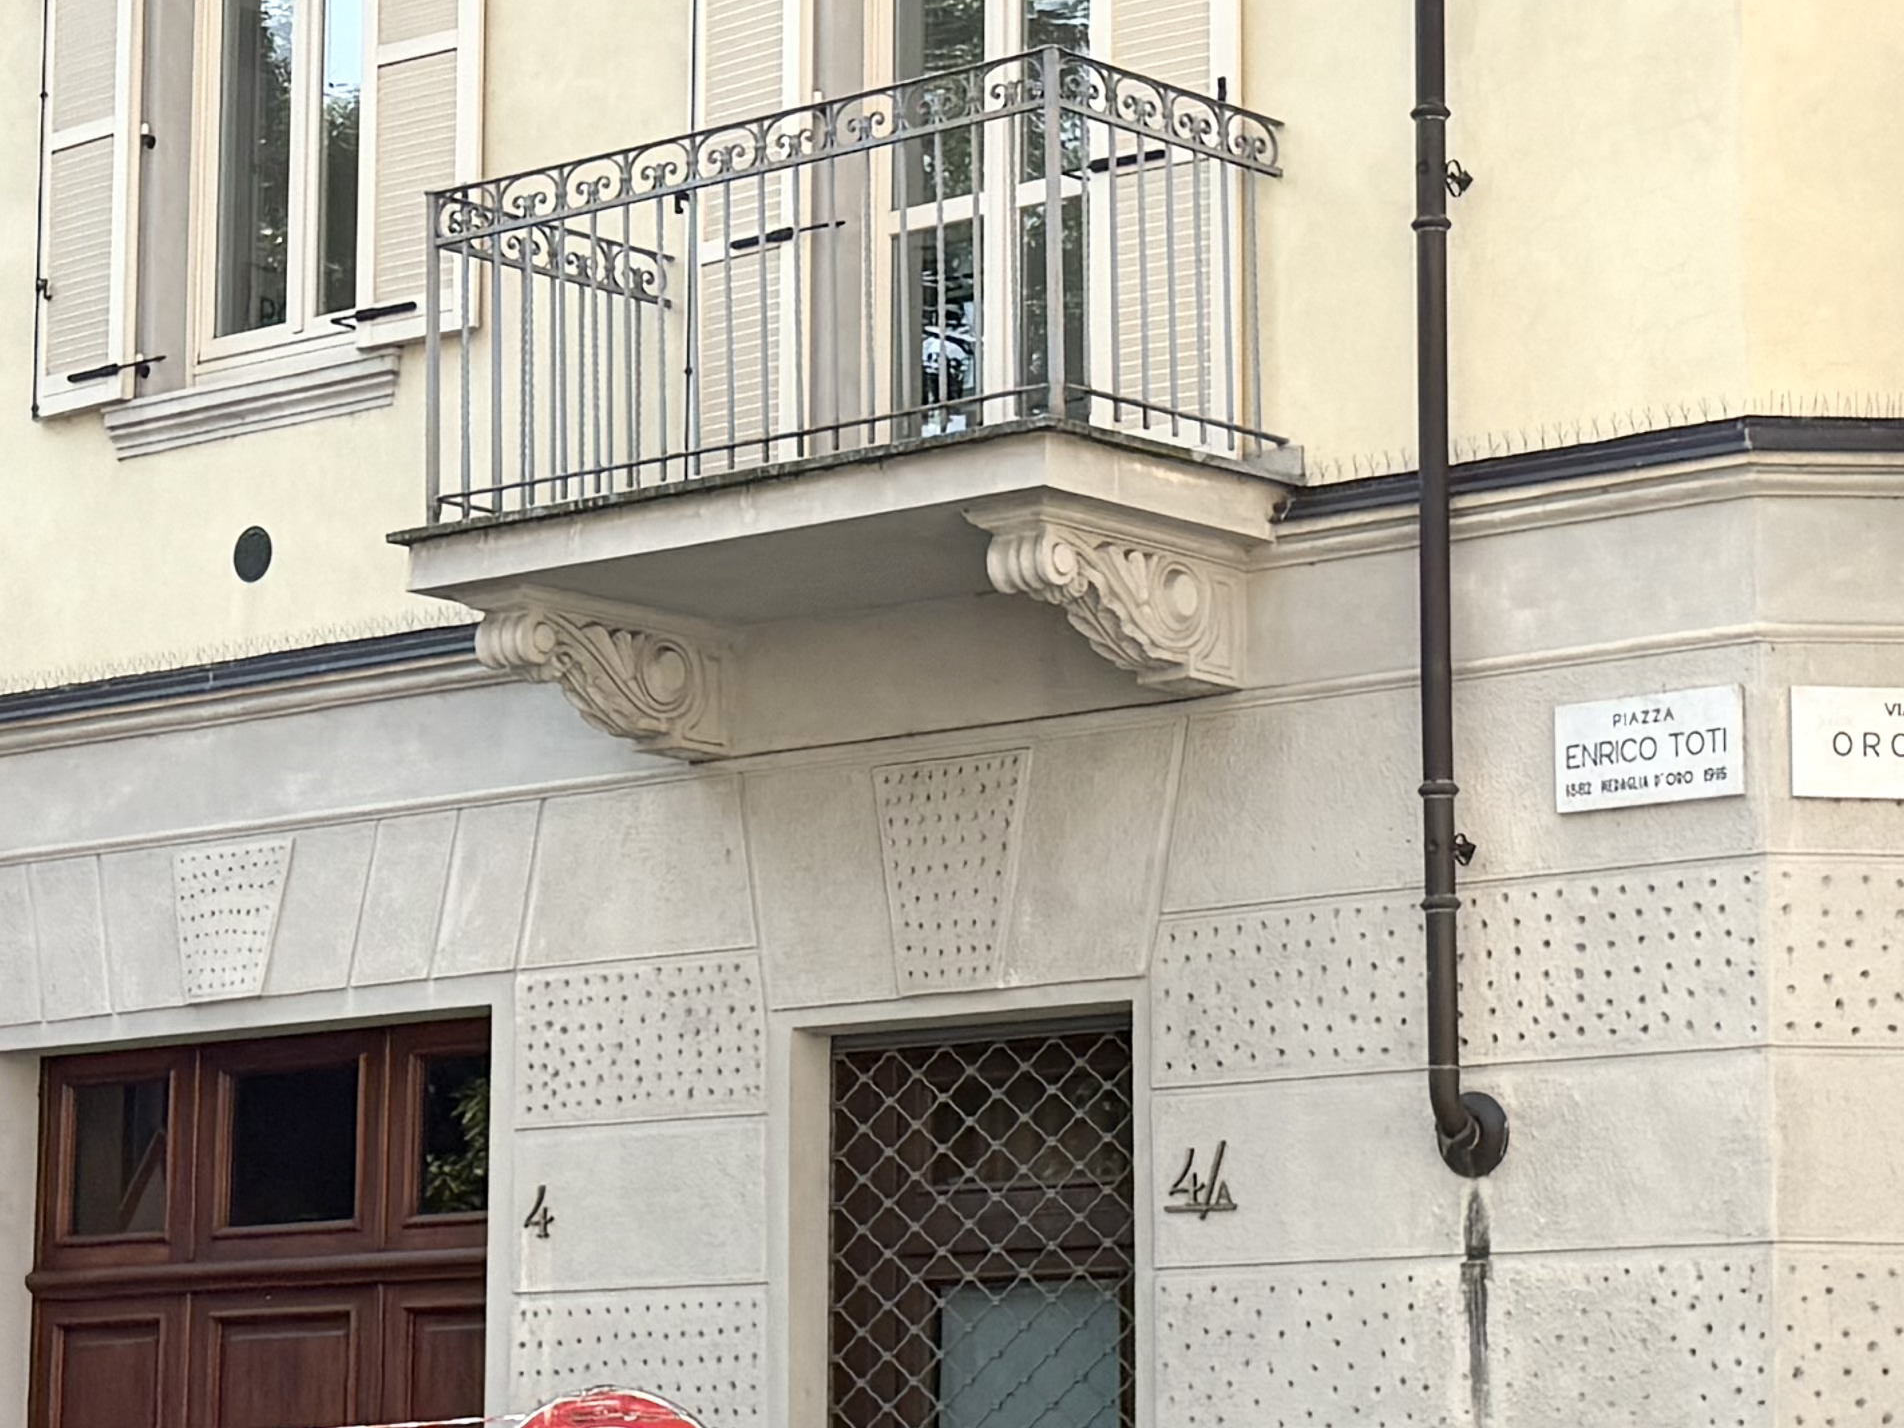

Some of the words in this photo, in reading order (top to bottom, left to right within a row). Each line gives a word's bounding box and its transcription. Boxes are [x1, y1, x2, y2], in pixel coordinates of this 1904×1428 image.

[1612, 707, 1675, 728] PIAZZA
[1565, 736, 1658, 770] ENRICO
[1667, 727, 1728, 758] TOTI
[523, 1184, 555, 1239] 4
